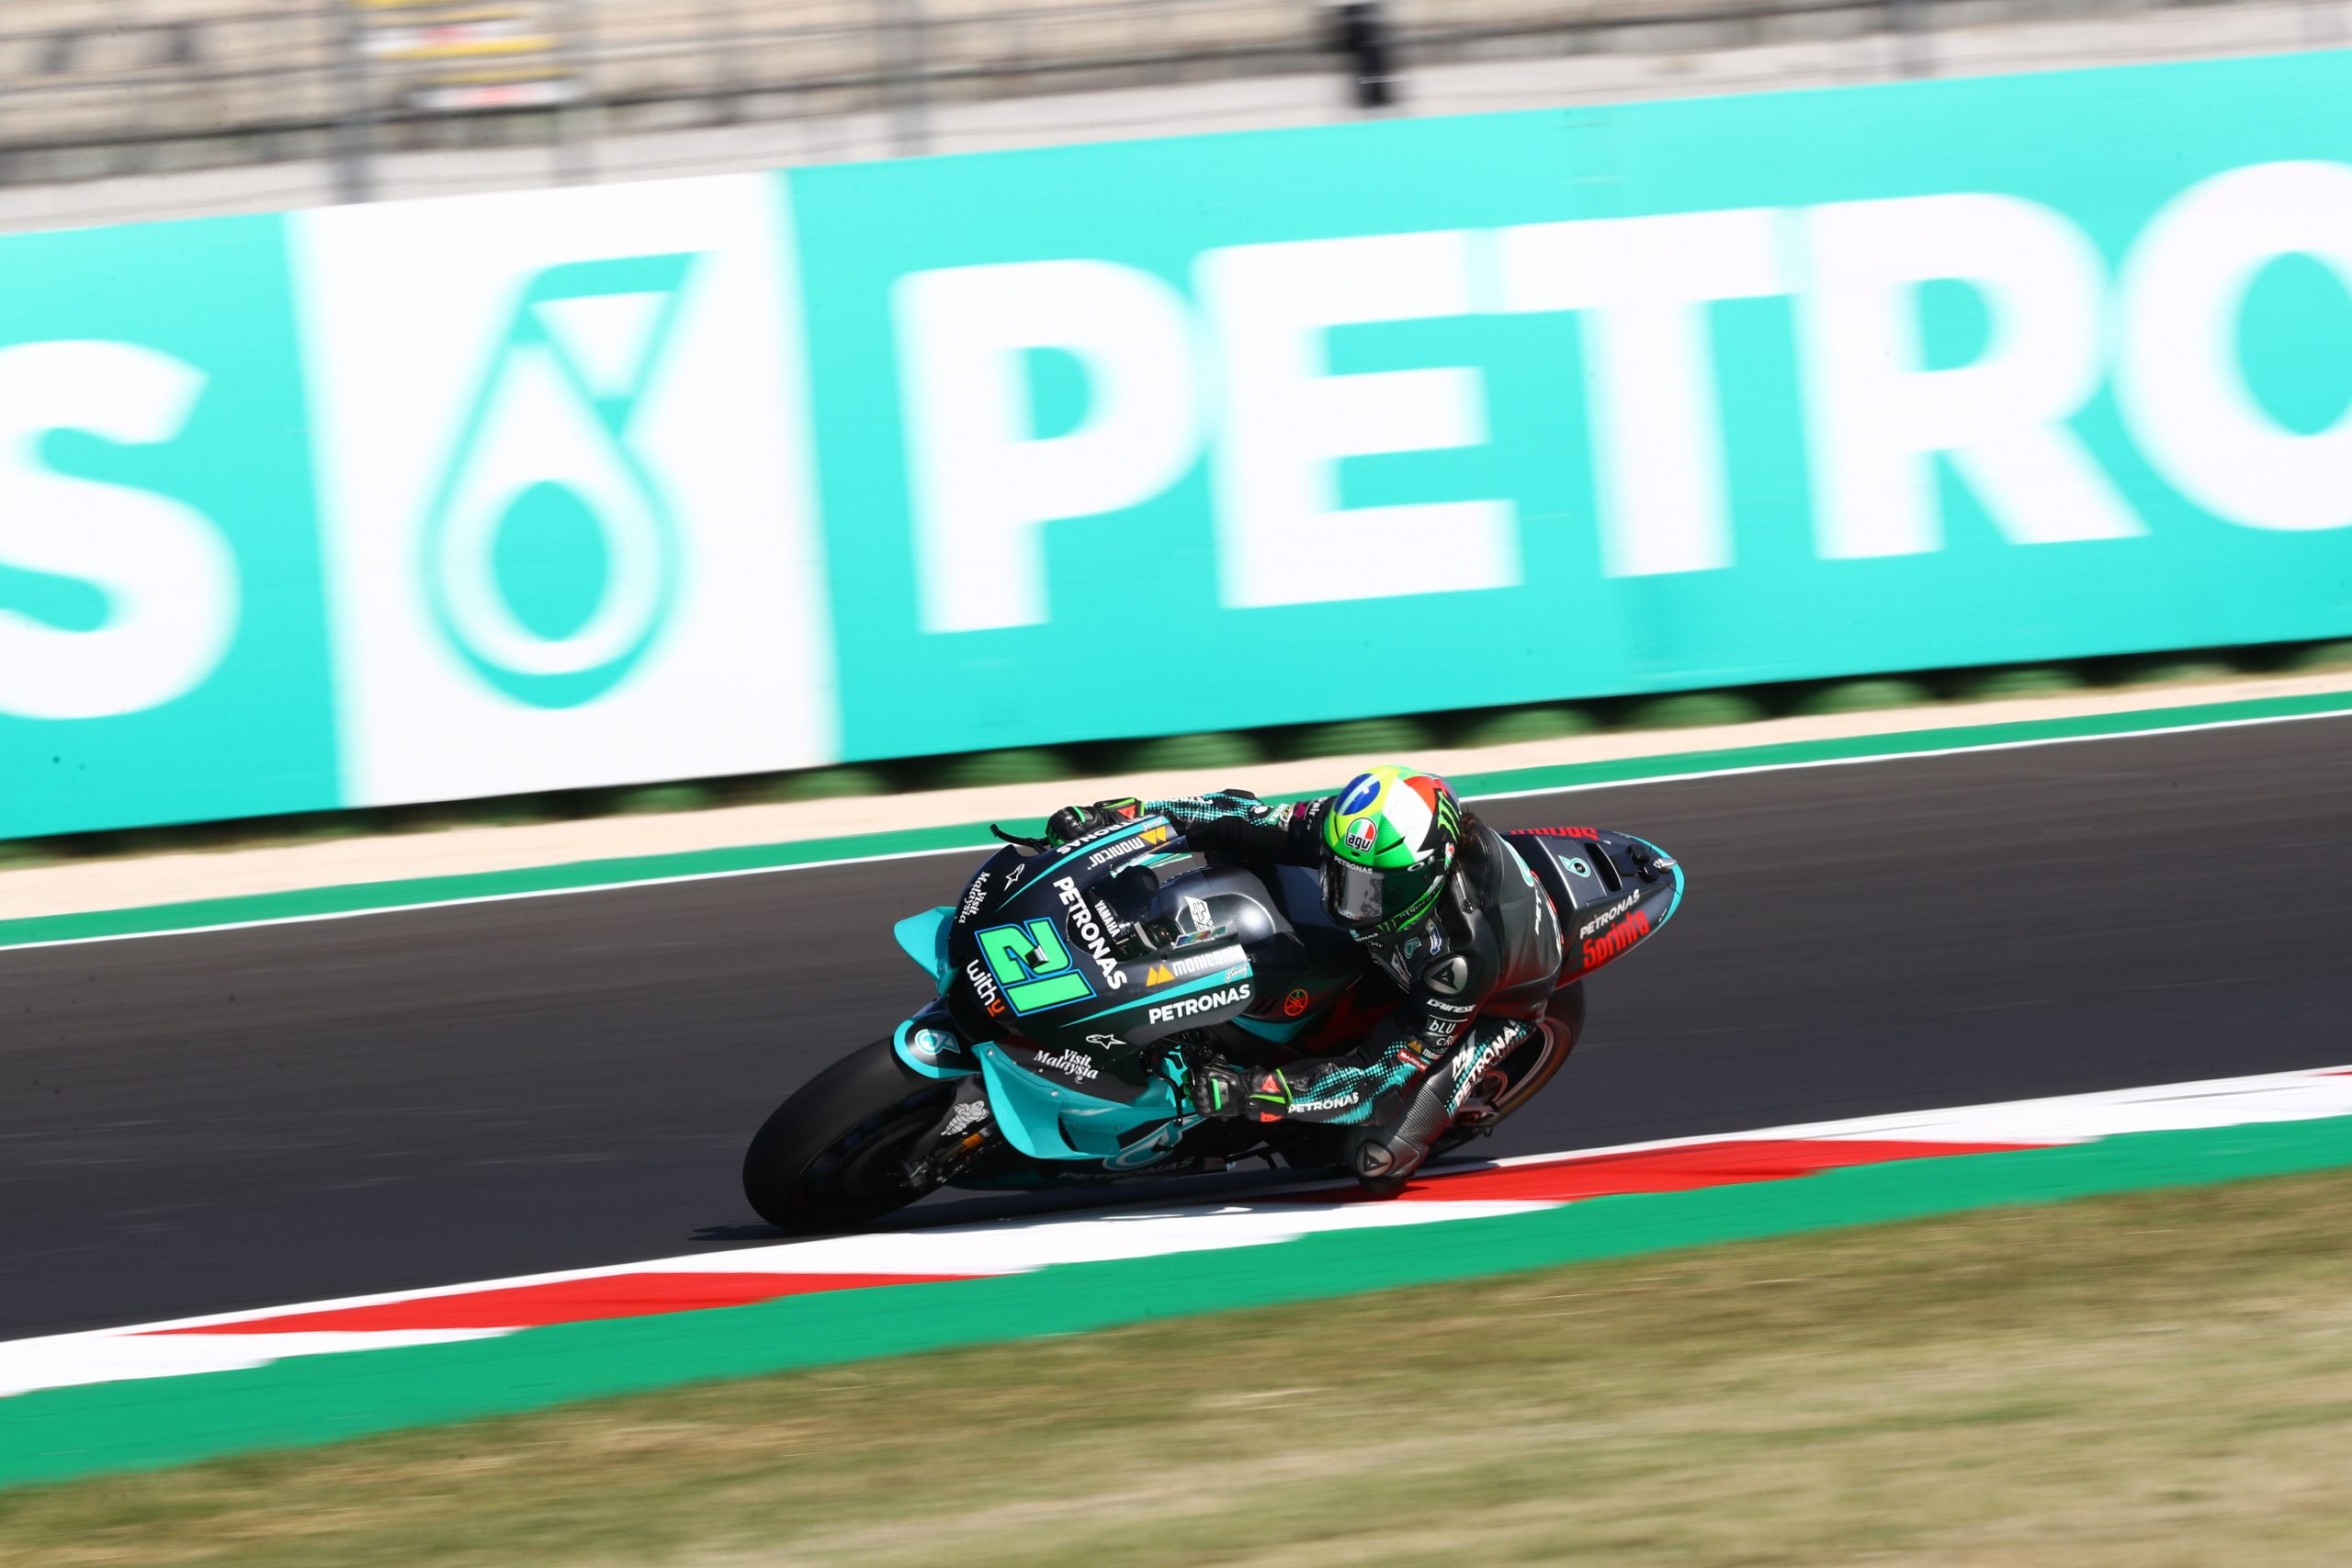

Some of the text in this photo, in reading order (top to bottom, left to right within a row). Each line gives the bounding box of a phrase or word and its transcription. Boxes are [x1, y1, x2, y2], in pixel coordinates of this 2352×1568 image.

[888, 159, 2352, 635] PETRO
[1347, 833, 1372, 850] agv
[1334, 855, 1374, 874] PETRONAS
[958, 872, 990, 924] Malaysia
[969, 892, 987, 915] Visit
[1579, 888, 1640, 939] PETRONAS
[1053, 875, 1128, 990] PETRONAS
[1094, 900, 1121, 938] YAMAHA
[975, 917, 1097, 1017] 21
[1148, 984, 1250, 1024] PETRONAS
[1033, 1050, 1099, 1079] Malaysia
[1064, 1049, 1091, 1066] Visit
[1454, 1020, 1521, 1108] PETRONA
[1287, 1092, 1360, 1113] PETRONAS
